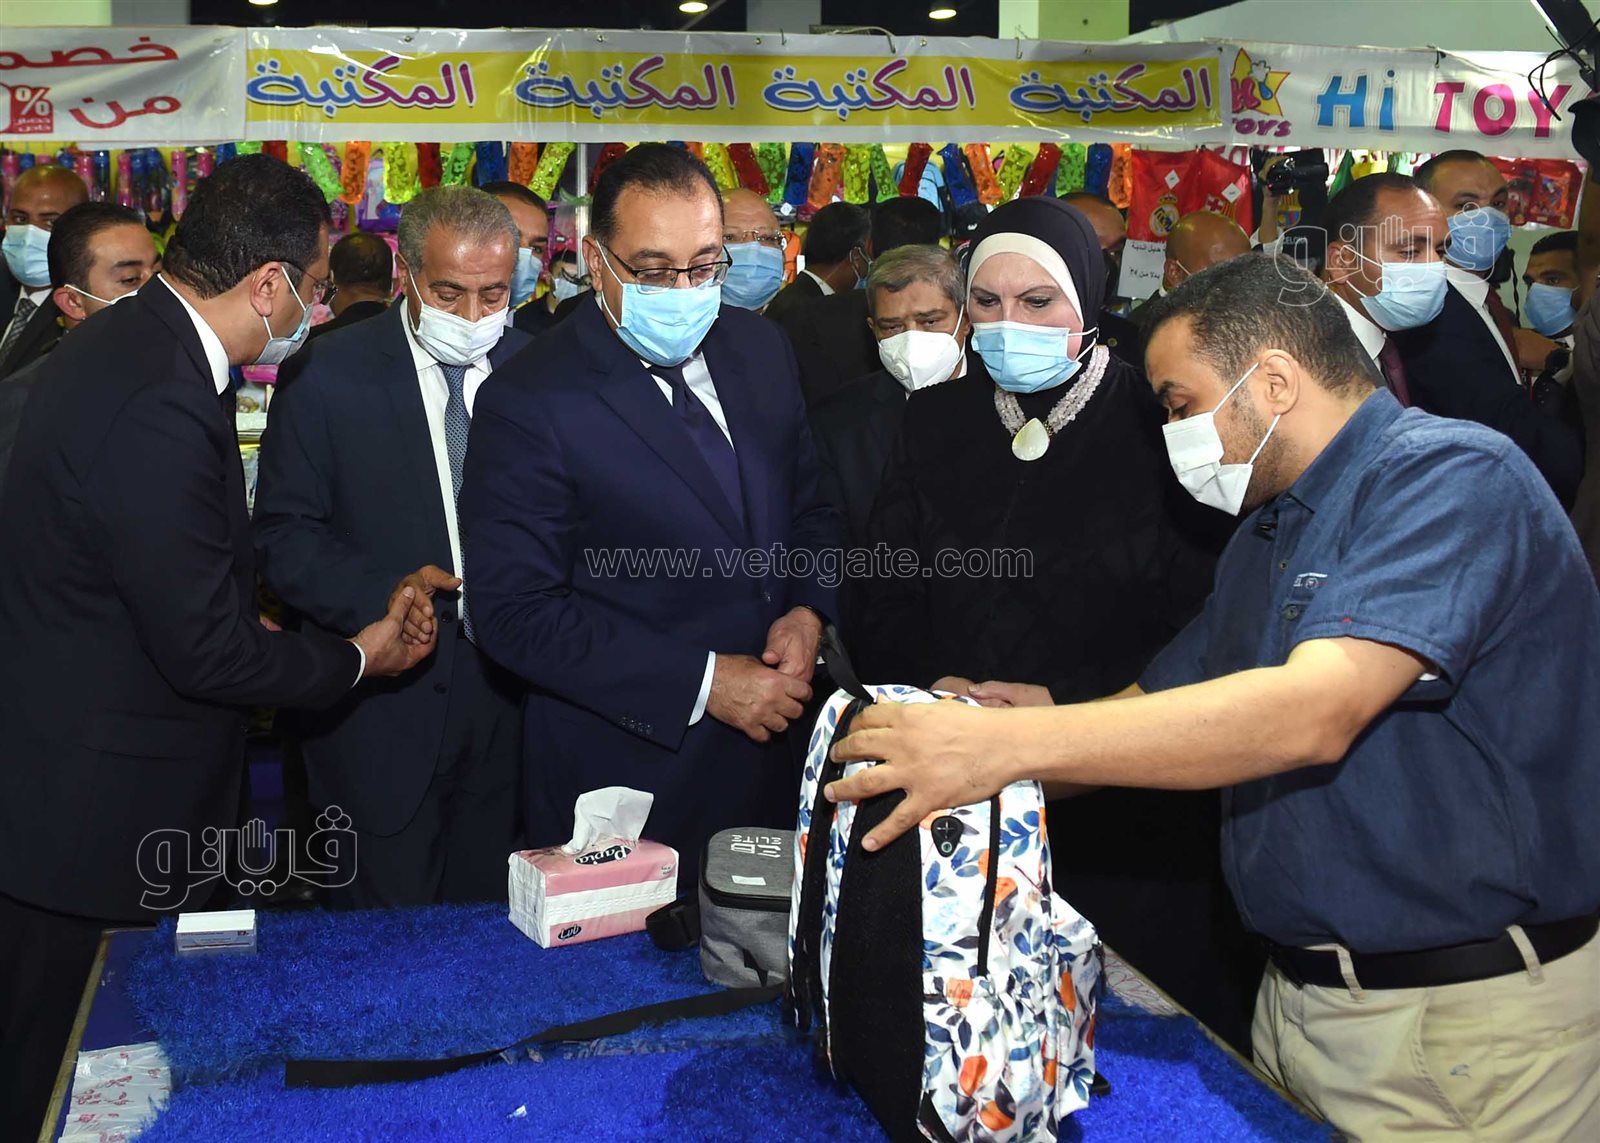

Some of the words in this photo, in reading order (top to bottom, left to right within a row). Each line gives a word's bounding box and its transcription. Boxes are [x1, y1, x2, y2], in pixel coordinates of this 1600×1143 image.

[69, 96, 182, 129] من
[247, 57, 475, 118] المكتبة
[515, 56, 737, 119] المكتبة
[763, 59, 976, 120] المكتبة
[1009, 63, 1213, 122] المكتبة
[1317, 70, 1396, 131] Hi
[1433, 82, 1574, 138] TOY
[578, 844, 629, 865] Papia
[731, 834, 782, 844] ELITE
